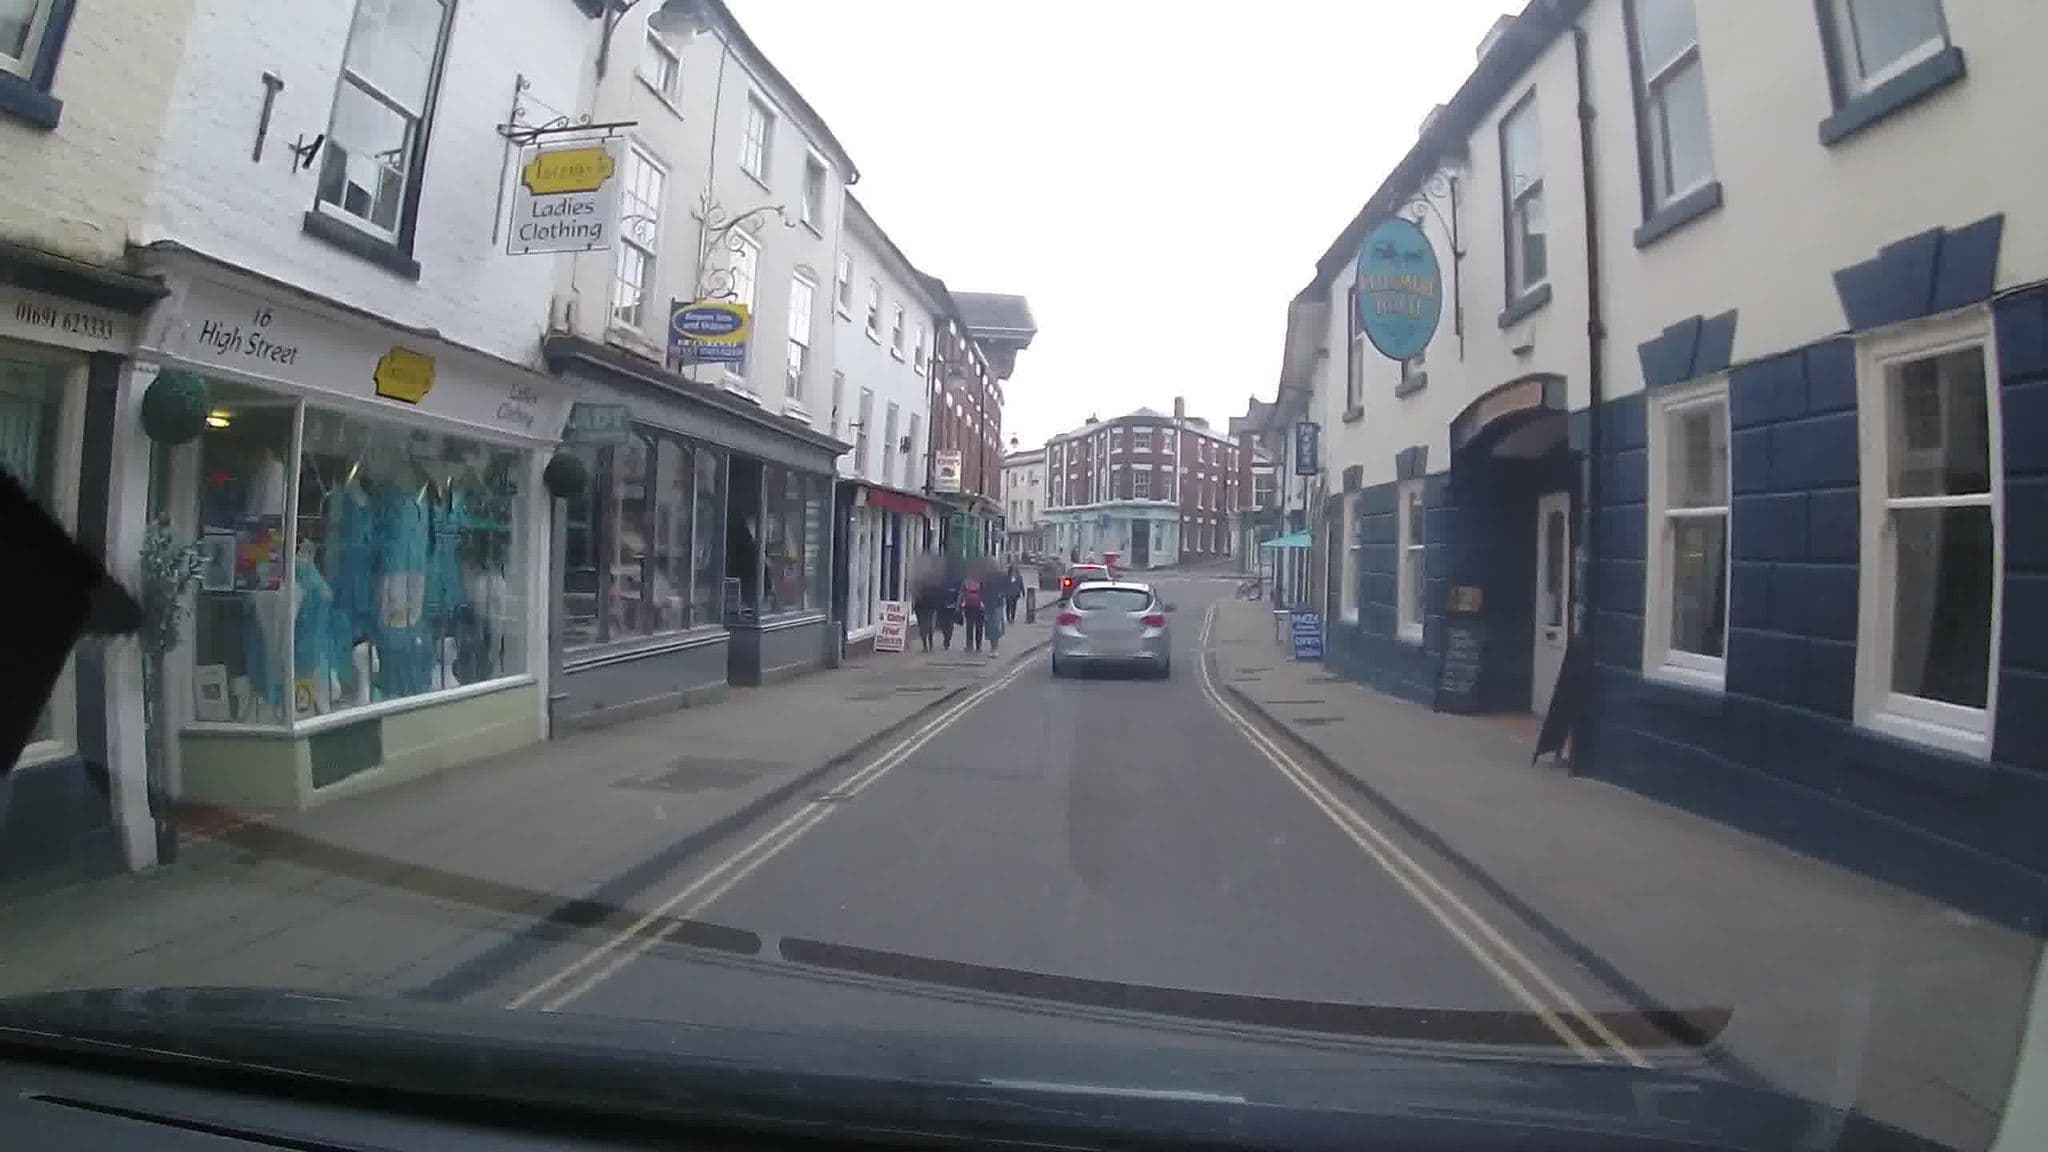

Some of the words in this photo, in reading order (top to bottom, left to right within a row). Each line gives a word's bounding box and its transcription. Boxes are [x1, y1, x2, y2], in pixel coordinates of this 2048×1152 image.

[532, 198, 594, 218] Ladies
[520, 219, 602, 241] Clothing
[15, 302, 57, 328] 01691
[255, 309, 272, 327] 16
[199, 319, 242, 355] High
[244, 332, 298, 366] Street
